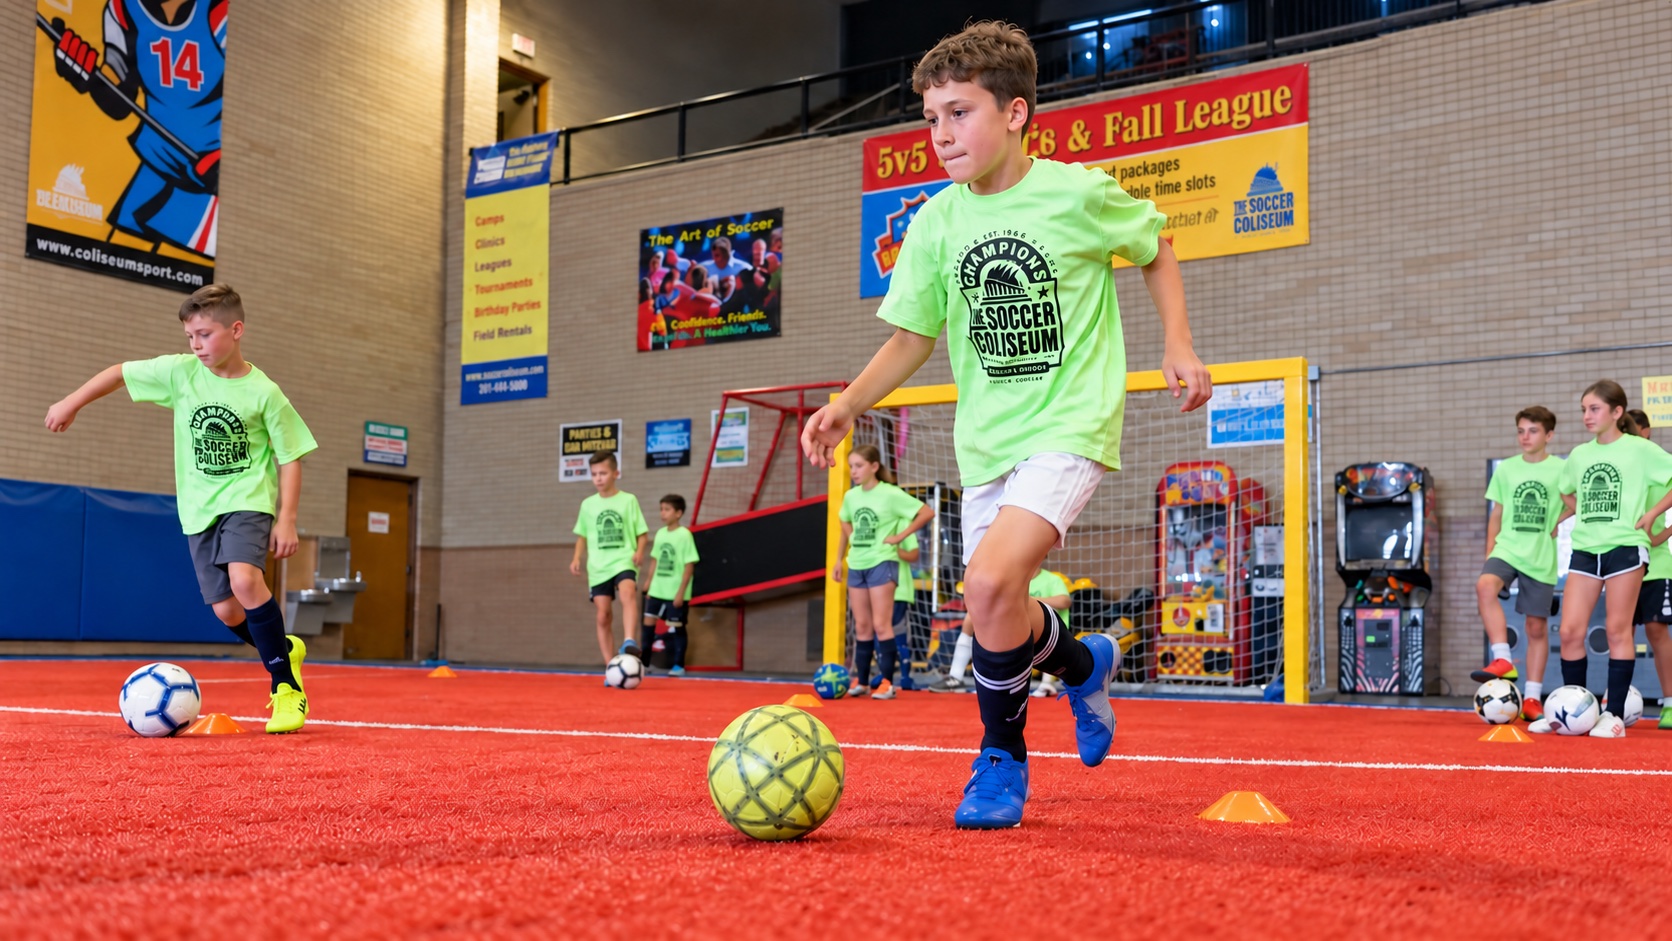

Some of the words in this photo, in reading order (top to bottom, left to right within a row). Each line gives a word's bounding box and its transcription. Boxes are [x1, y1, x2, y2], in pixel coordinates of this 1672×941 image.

[151, 36, 204, 92] 14
[877, 140, 928, 179] 5v5
[1067, 119, 1092, 152] &
[1103, 102, 1164, 147] Fall
[1174, 85, 1293, 130] League
[1120, 158, 1180, 184] packages
[1155, 180, 1182, 197] time
[1186, 174, 1216, 192] slots
[1249, 192, 1294, 214] SOCCER
[475, 214, 504, 227] Camps
[1234, 209, 1294, 234] COLISEUM
[475, 237, 505, 250] Clinics
[648, 234, 674, 247] The
[680, 228, 702, 242] Art
[706, 224, 722, 238] of
[727, 219, 774, 236] Soccer
[1003, 229, 1027, 239] 1966
[36, 238, 203, 286] www.coliseumsport.com
[475, 258, 512, 273] Leagues
[475, 277, 533, 294] Tournaments
[474, 304, 510, 318] Birthday
[511, 300, 541, 312] Parties
[986, 301, 1057, 331] SOCCER
[473, 328, 495, 341] Field
[497, 324, 533, 339] Rentals
[974, 327, 1059, 358] COLISEUM
